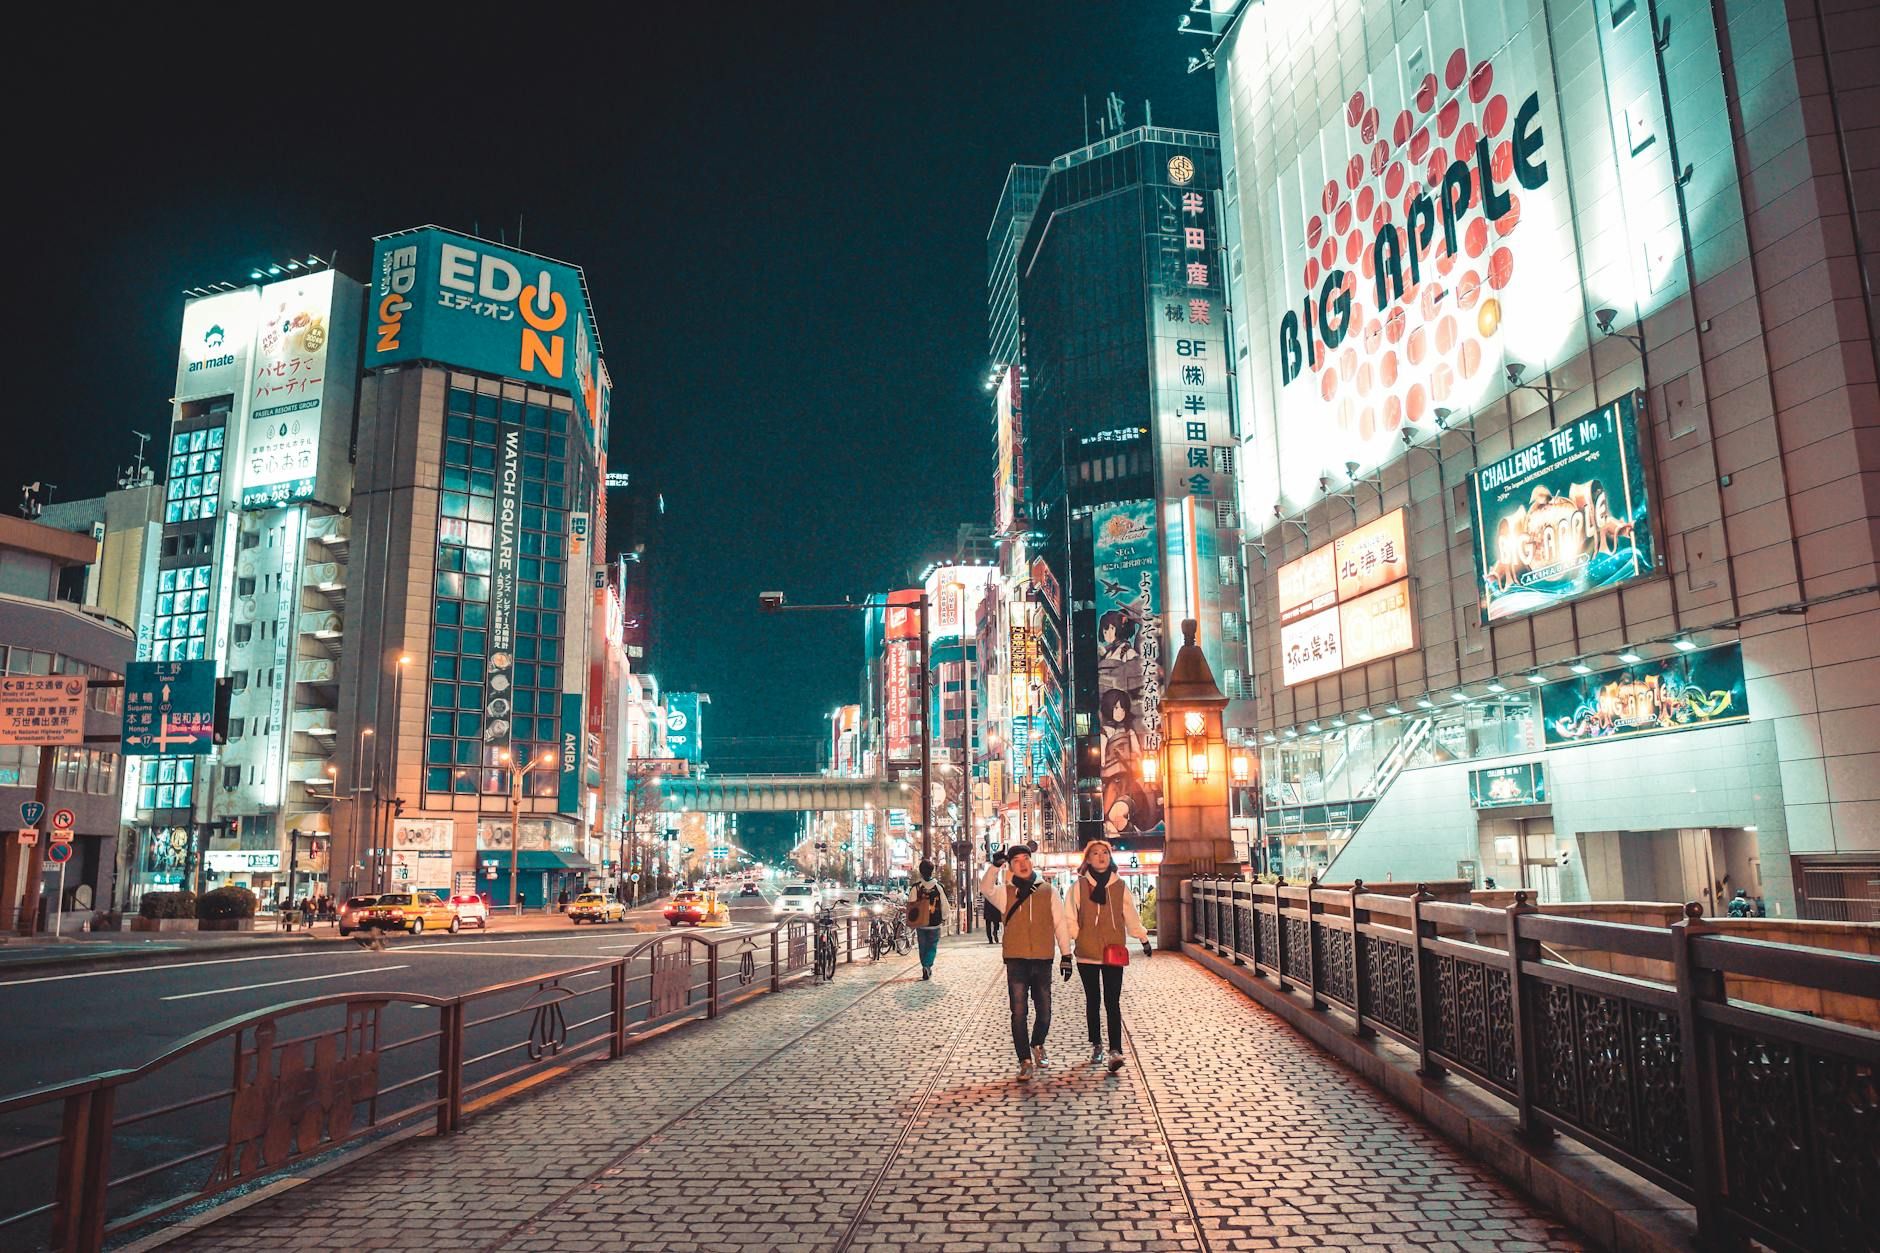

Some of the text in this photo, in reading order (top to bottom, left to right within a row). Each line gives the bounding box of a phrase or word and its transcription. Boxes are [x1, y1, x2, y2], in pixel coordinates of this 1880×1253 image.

[1280, 270, 1350, 386] BIG
[1374, 90, 1549, 312] APPLE
[1182, 191, 1211, 324] 半田産業
[438, 290, 514, 320] エディオン
[1176, 339, 1205, 357] 8F
[189, 354, 234, 372] animate
[256, 377, 322, 398] パーティー
[298, 399, 318, 410] GROUP
[1482, 409, 1612, 491] CHALLENGE THE No. 1
[499, 432, 518, 571] WATCH SQUARE
[1342, 540, 1398, 581] 北海道
[154, 663, 181, 674] 上野
[16, 681, 63, 690] 国土交通省
[128, 692, 153, 703] 巣鴨
[6, 706, 78, 716] 東京国道事務所
[128, 704, 153, 712] Sugamo
[12, 717, 69, 727] 万世橋出張所
[127, 713, 152, 724] 本郷
[172, 712, 211, 725] 昭和通り
[564, 732, 577, 773] AKIBA
[27, 807, 37, 817] 17
